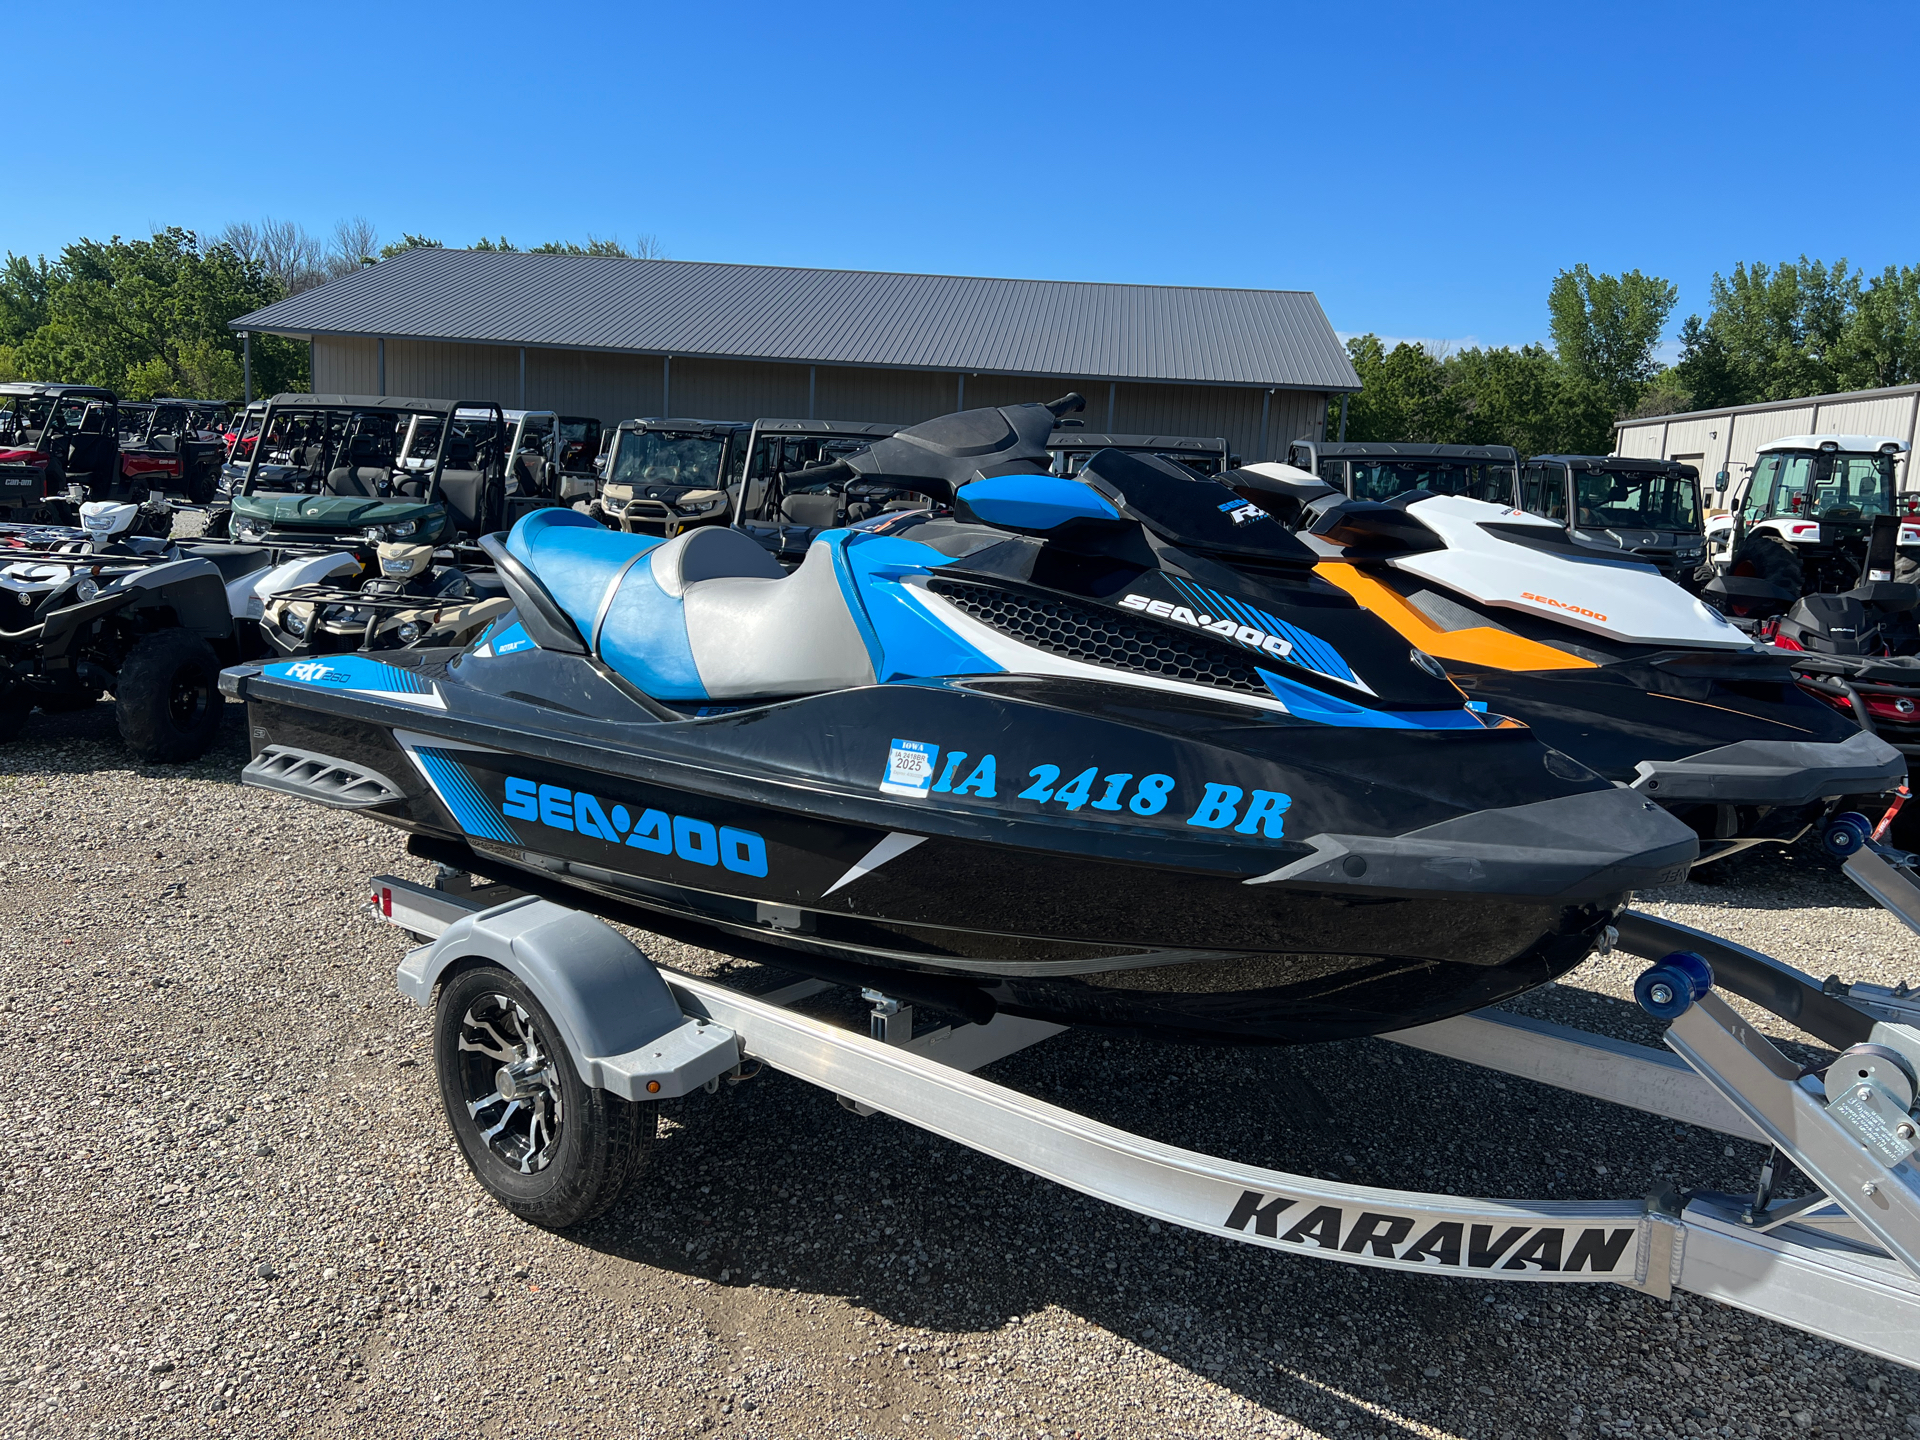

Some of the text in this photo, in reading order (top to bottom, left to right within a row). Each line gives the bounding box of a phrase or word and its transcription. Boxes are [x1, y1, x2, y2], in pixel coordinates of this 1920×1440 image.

[285, 662, 351, 683] RXT 260
[902, 741, 924, 752] IOWA
[896, 757, 923, 772] 2025
[932, 751, 1293, 839] IA 2418 BR
[1223, 1190, 1635, 1272] KARAVAN
